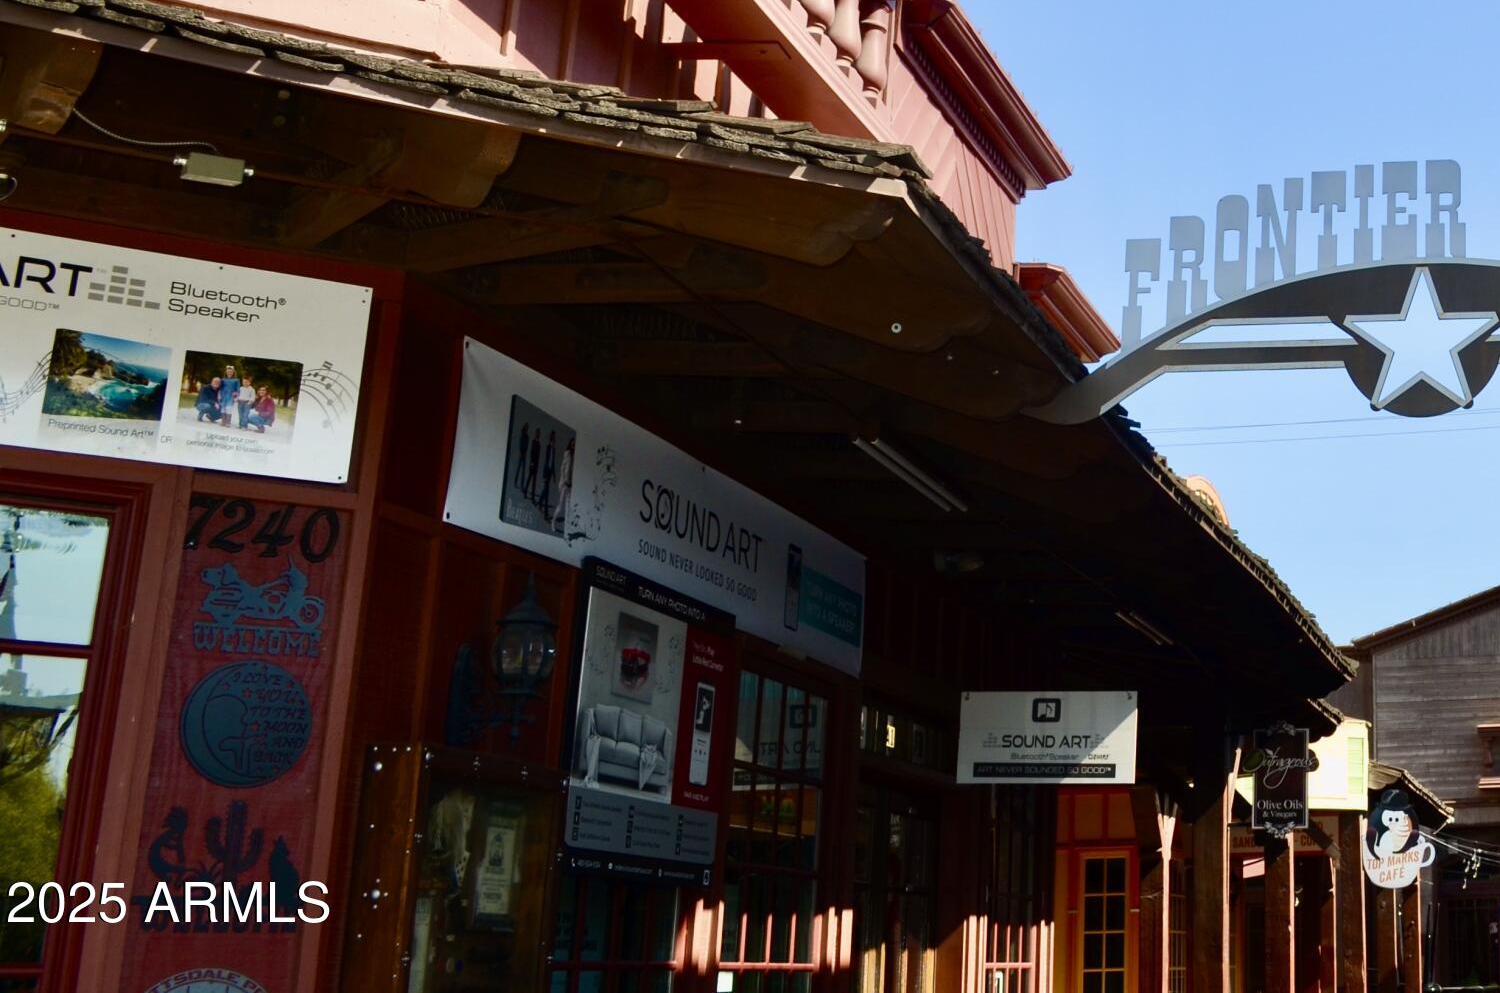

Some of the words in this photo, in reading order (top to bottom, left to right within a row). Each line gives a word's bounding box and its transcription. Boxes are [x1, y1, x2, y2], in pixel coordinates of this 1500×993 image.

[1121, 159, 1466, 356] FRONTIER
[168, 298, 260, 323] Speaker
[48, 418, 96, 433] Preprinted
[98, 424, 129, 437] Sound
[160, 435, 173, 444] OR
[184, 495, 339, 563] 7240
[640, 479, 721, 552] SOUND
[722, 522, 763, 573] ART
[638, 539, 667, 563] SOUND
[669, 552, 694, 574] NEVER
[695, 565, 724, 587] LOOKED
[725, 576, 735, 593] SO
[737, 581, 758, 602] GOOD
[193, 621, 322, 658] WELCOME
[274, 707, 307, 720] THE
[1002, 734, 1055, 748] SOUND
[1059, 735, 1091, 748] ART
[1024, 765, 1065, 774] SOUNDED
[1067, 766, 1079, 774] SO
[1257, 799, 1281, 810] Olive
[1283, 799, 1303, 810] Oils
[1367, 858, 1385, 870] TOP
[1387, 850, 1420, 868] MARKS
